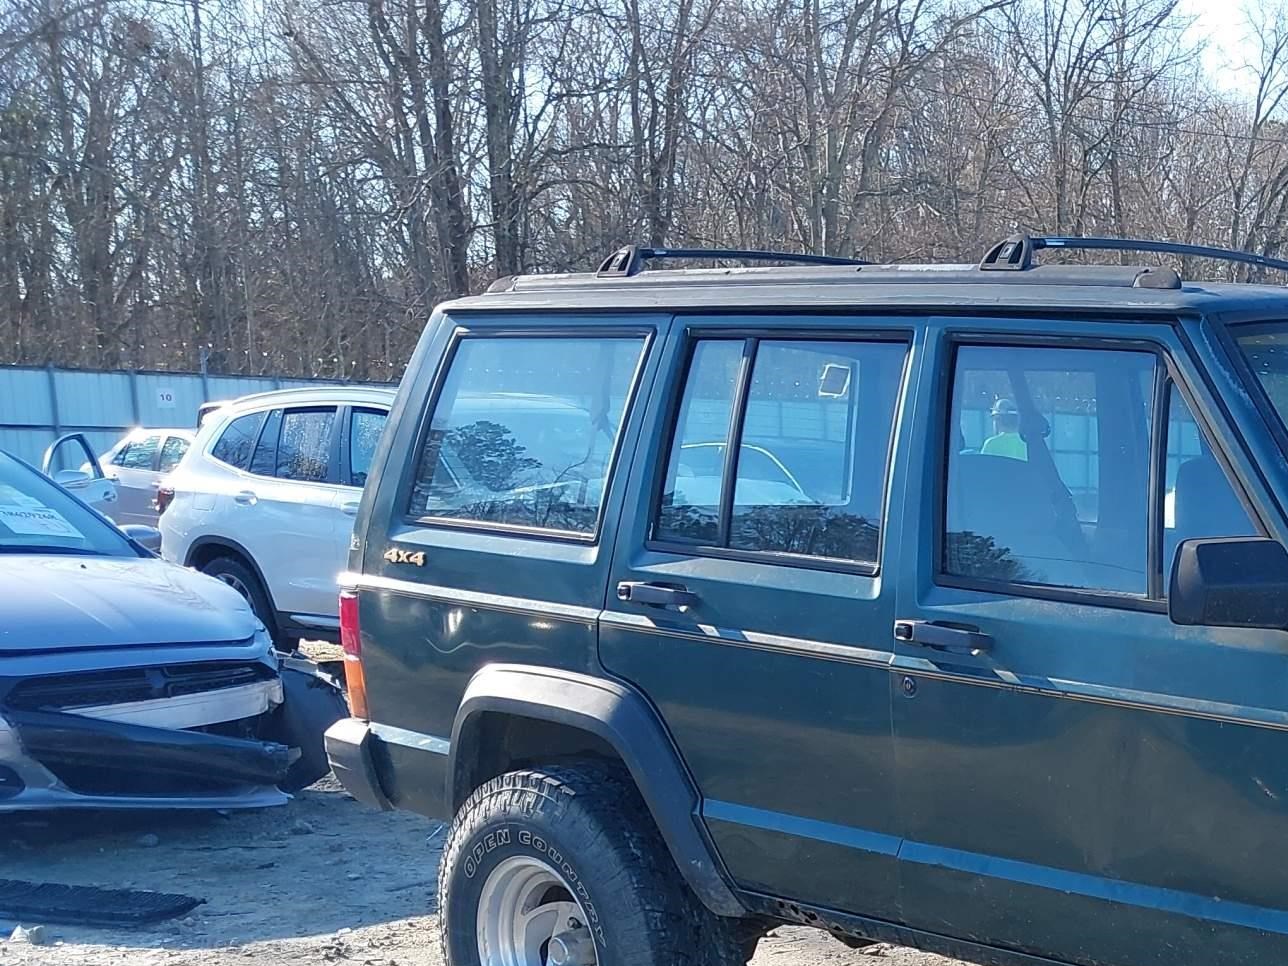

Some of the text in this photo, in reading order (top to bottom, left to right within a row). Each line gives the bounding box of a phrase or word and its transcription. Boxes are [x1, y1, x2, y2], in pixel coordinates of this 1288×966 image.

[159, 393, 172, 401] 10
[383, 548, 426, 567] 4x4
[463, 828, 607, 948] OPEN COUNTRY
